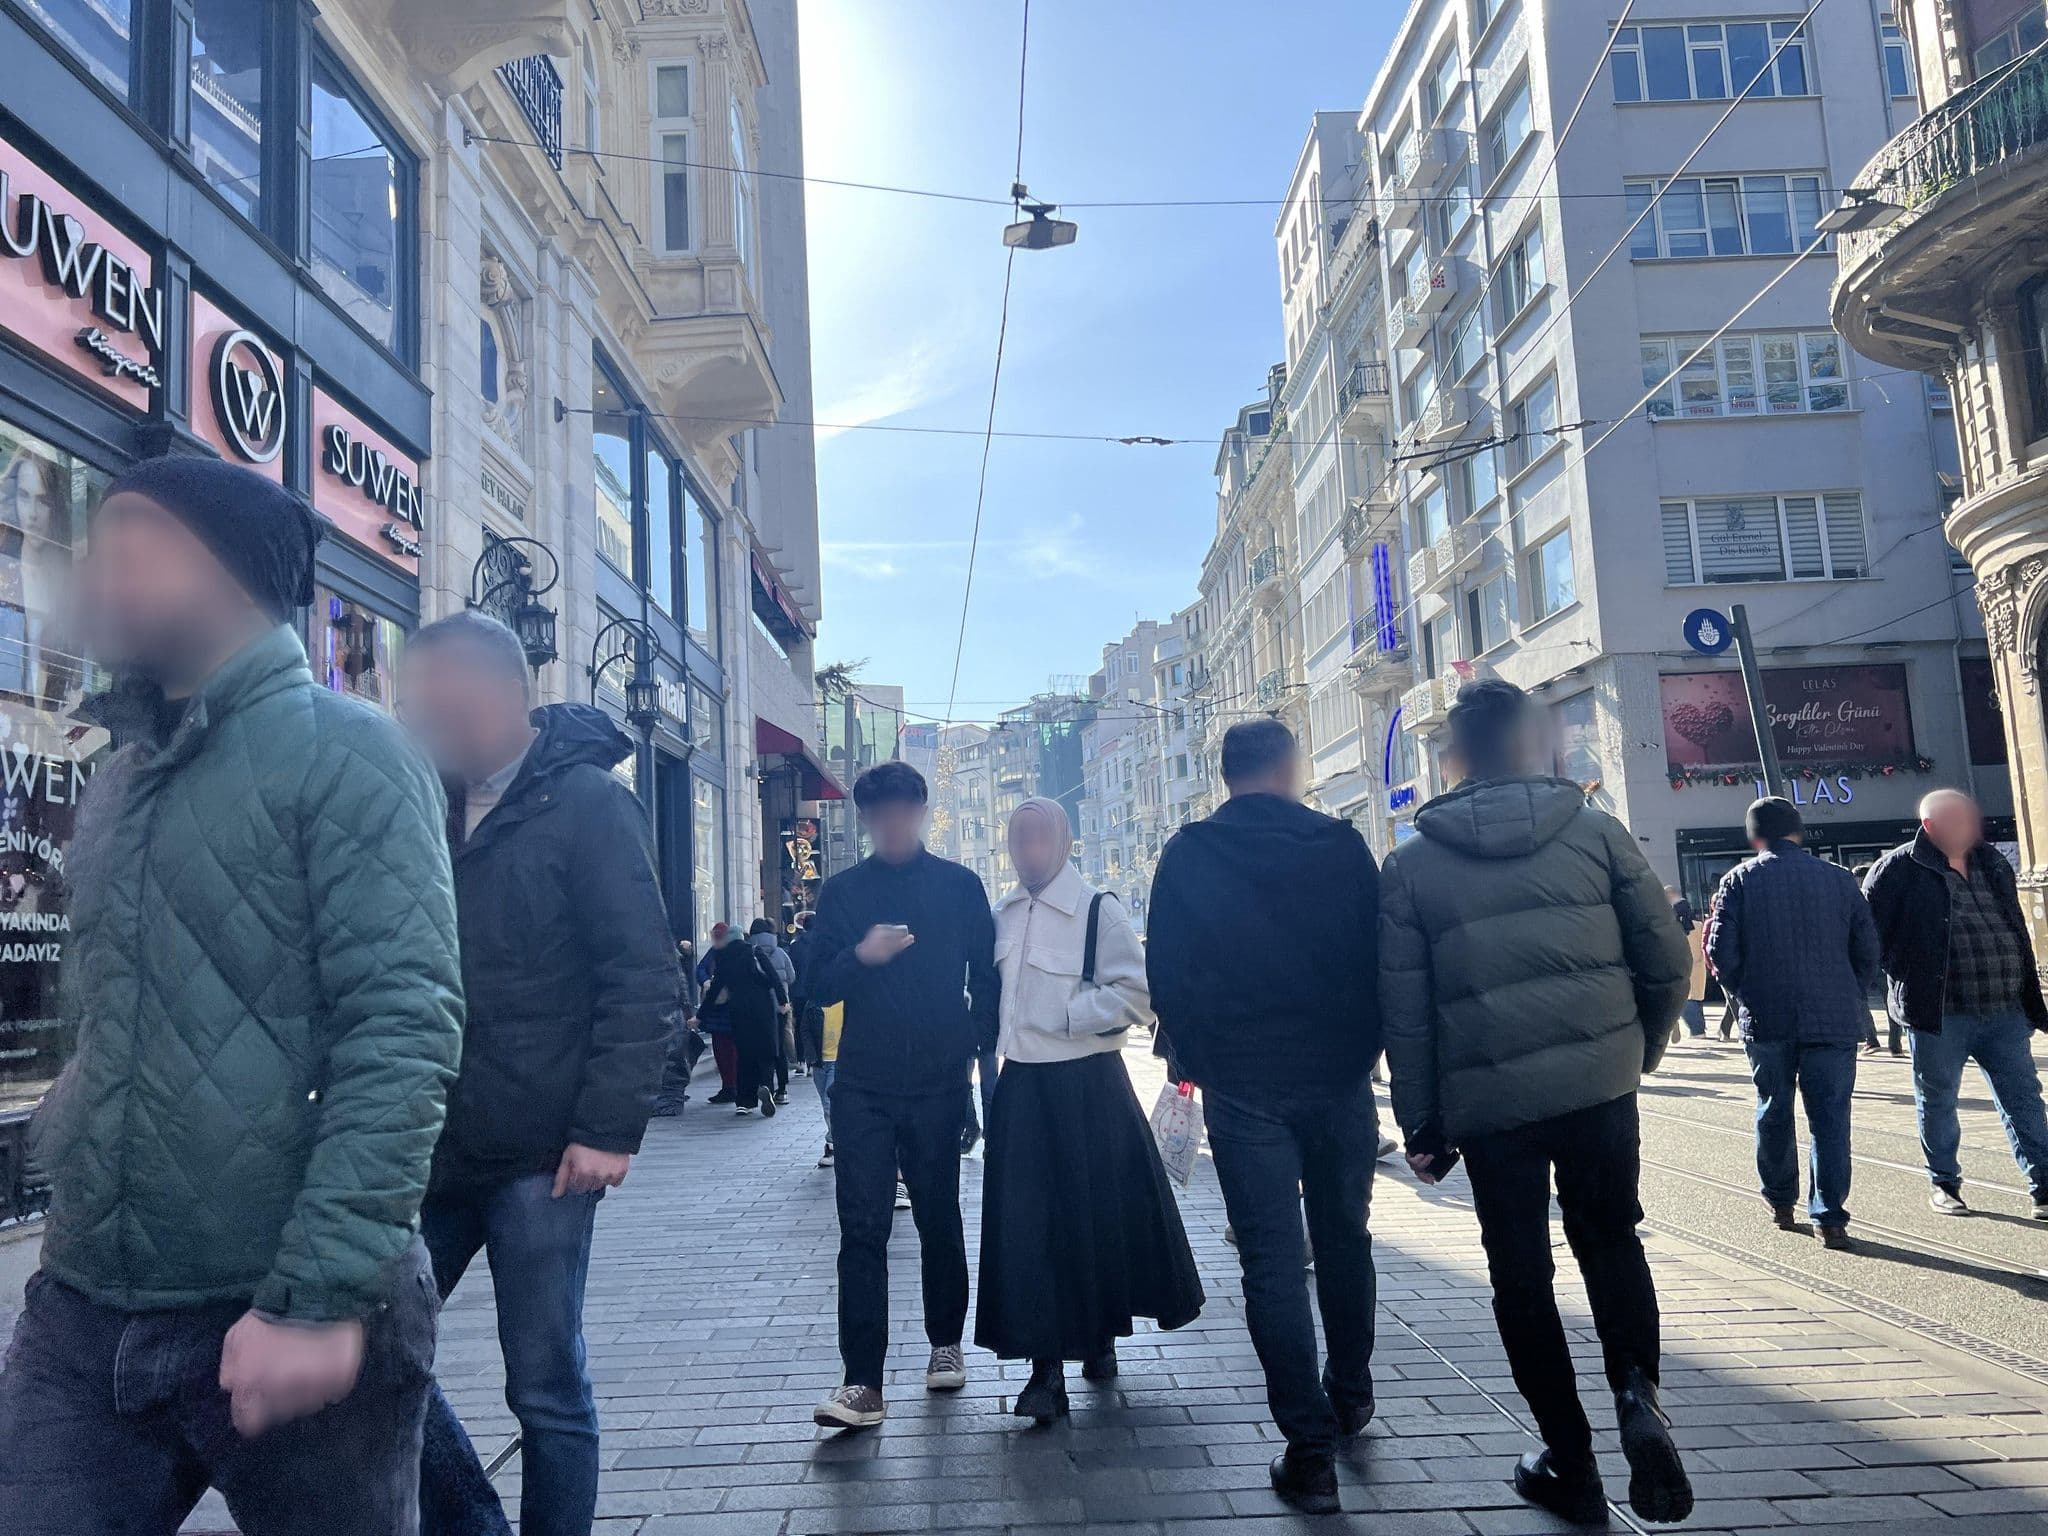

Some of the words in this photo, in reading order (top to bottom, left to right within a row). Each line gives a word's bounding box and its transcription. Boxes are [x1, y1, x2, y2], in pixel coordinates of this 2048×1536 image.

[85, 327, 161, 388] lingerie
[332, 425, 424, 531] SUWEN
[1802, 679, 1837, 690] LELAS
[1838, 699, 1880, 722] Günü
[1787, 745, 1812, 755] Happy
[1849, 741, 1865, 751] Day
[0, 943, 61, 962] ADAYIZ
